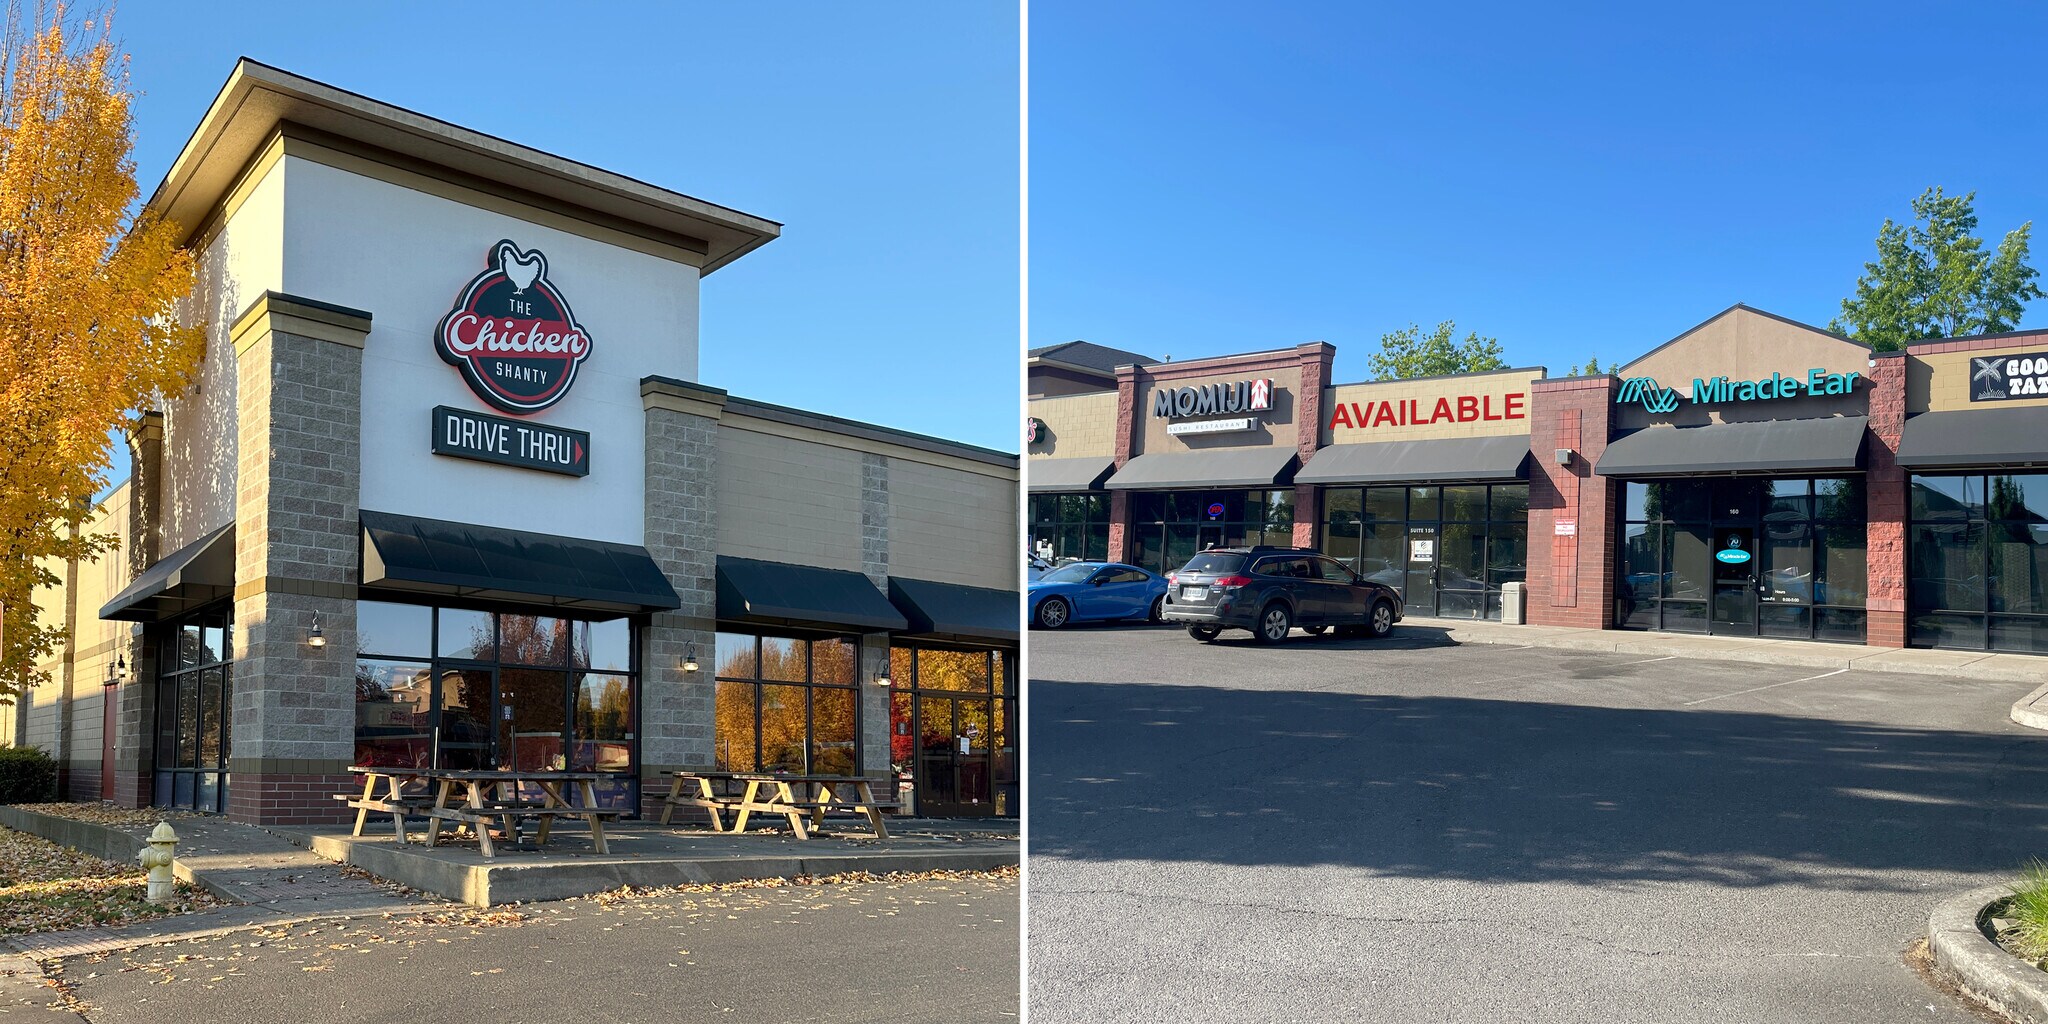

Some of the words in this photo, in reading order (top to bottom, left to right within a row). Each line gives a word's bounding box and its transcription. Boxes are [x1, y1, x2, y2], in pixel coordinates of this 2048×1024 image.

[509, 298, 532, 316] THE
[450, 314, 586, 354] Chicken
[496, 361, 547, 385] SHANTY
[1153, 380, 1252, 418] MOMIJI
[1328, 393, 1525, 430] AVAILABLE
[447, 415, 510, 455] DRIVE
[517, 427, 571, 465] THRU
[1195, 421, 1245, 430] RESTAURANT
